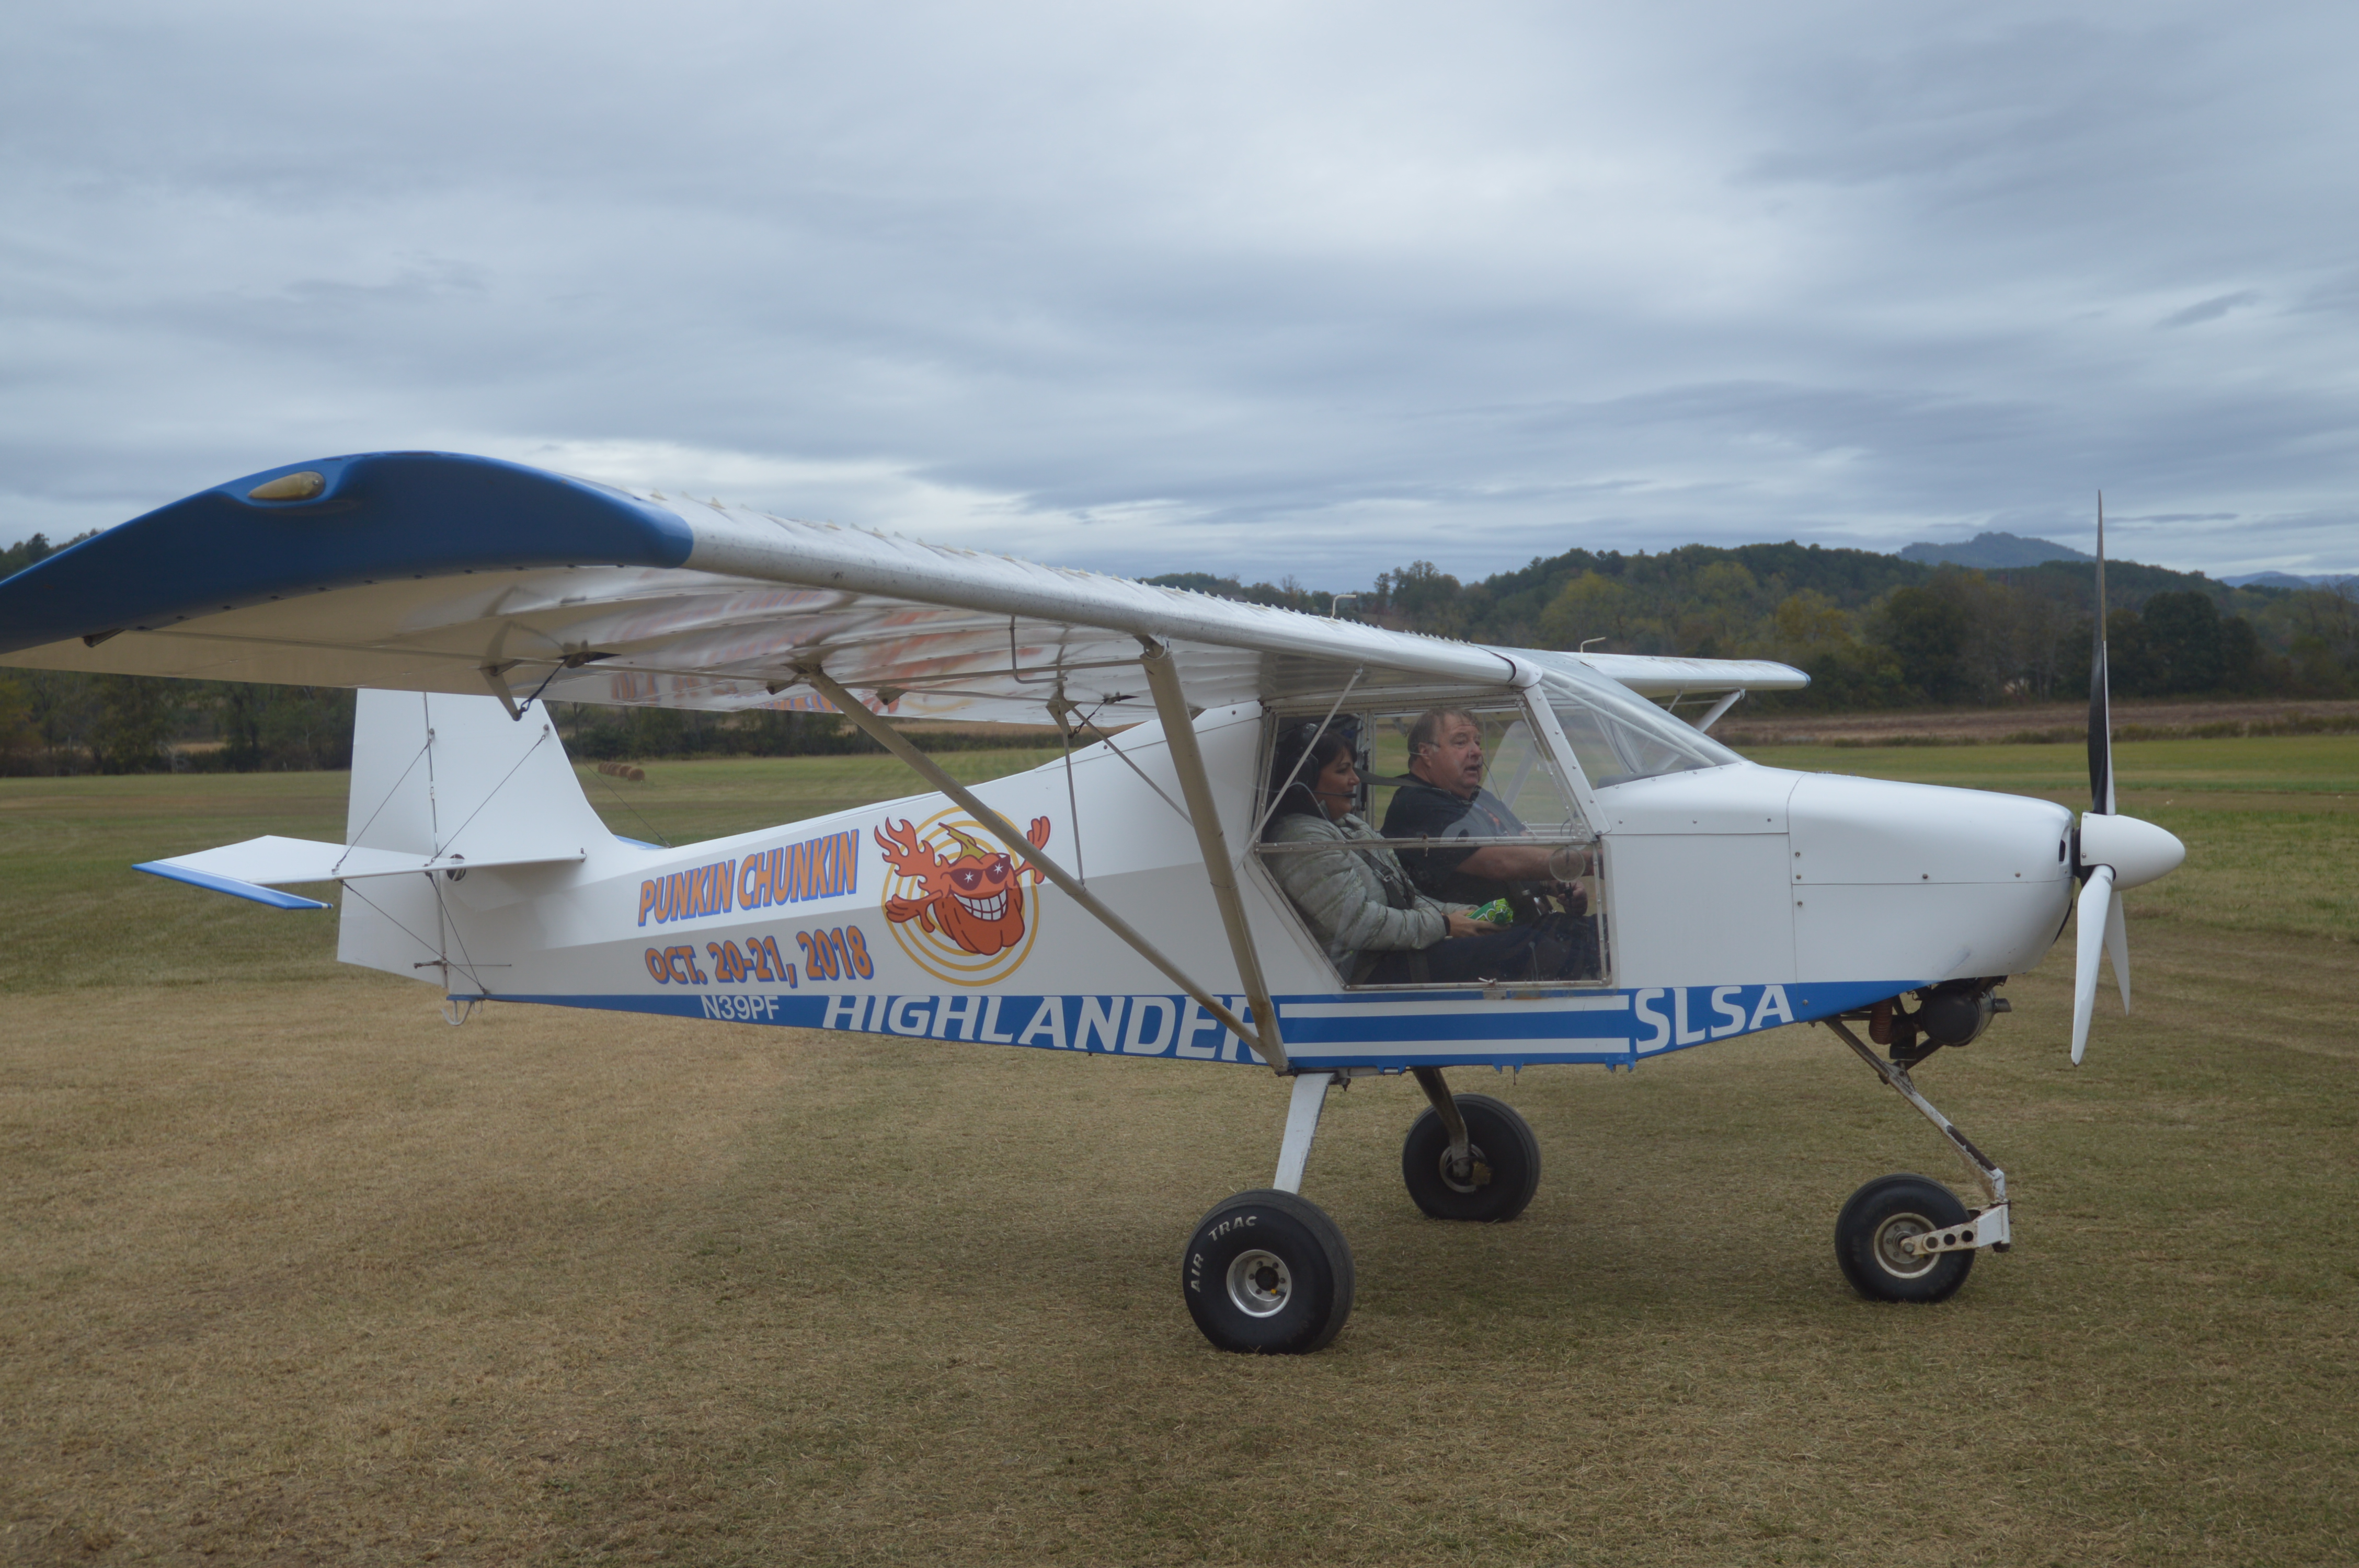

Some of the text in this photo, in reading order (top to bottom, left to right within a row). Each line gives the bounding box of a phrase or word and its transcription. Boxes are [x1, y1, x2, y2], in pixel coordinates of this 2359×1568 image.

[638, 829, 860, 927] PUNKIN CHUNKIN
[645, 925, 874, 989] OCT. 20-21, 2018
[700, 995, 780, 1020] N39PF
[1635, 985, 1794, 1053] SLSA
[1190, 1216, 1257, 1293] AIR TRAC
